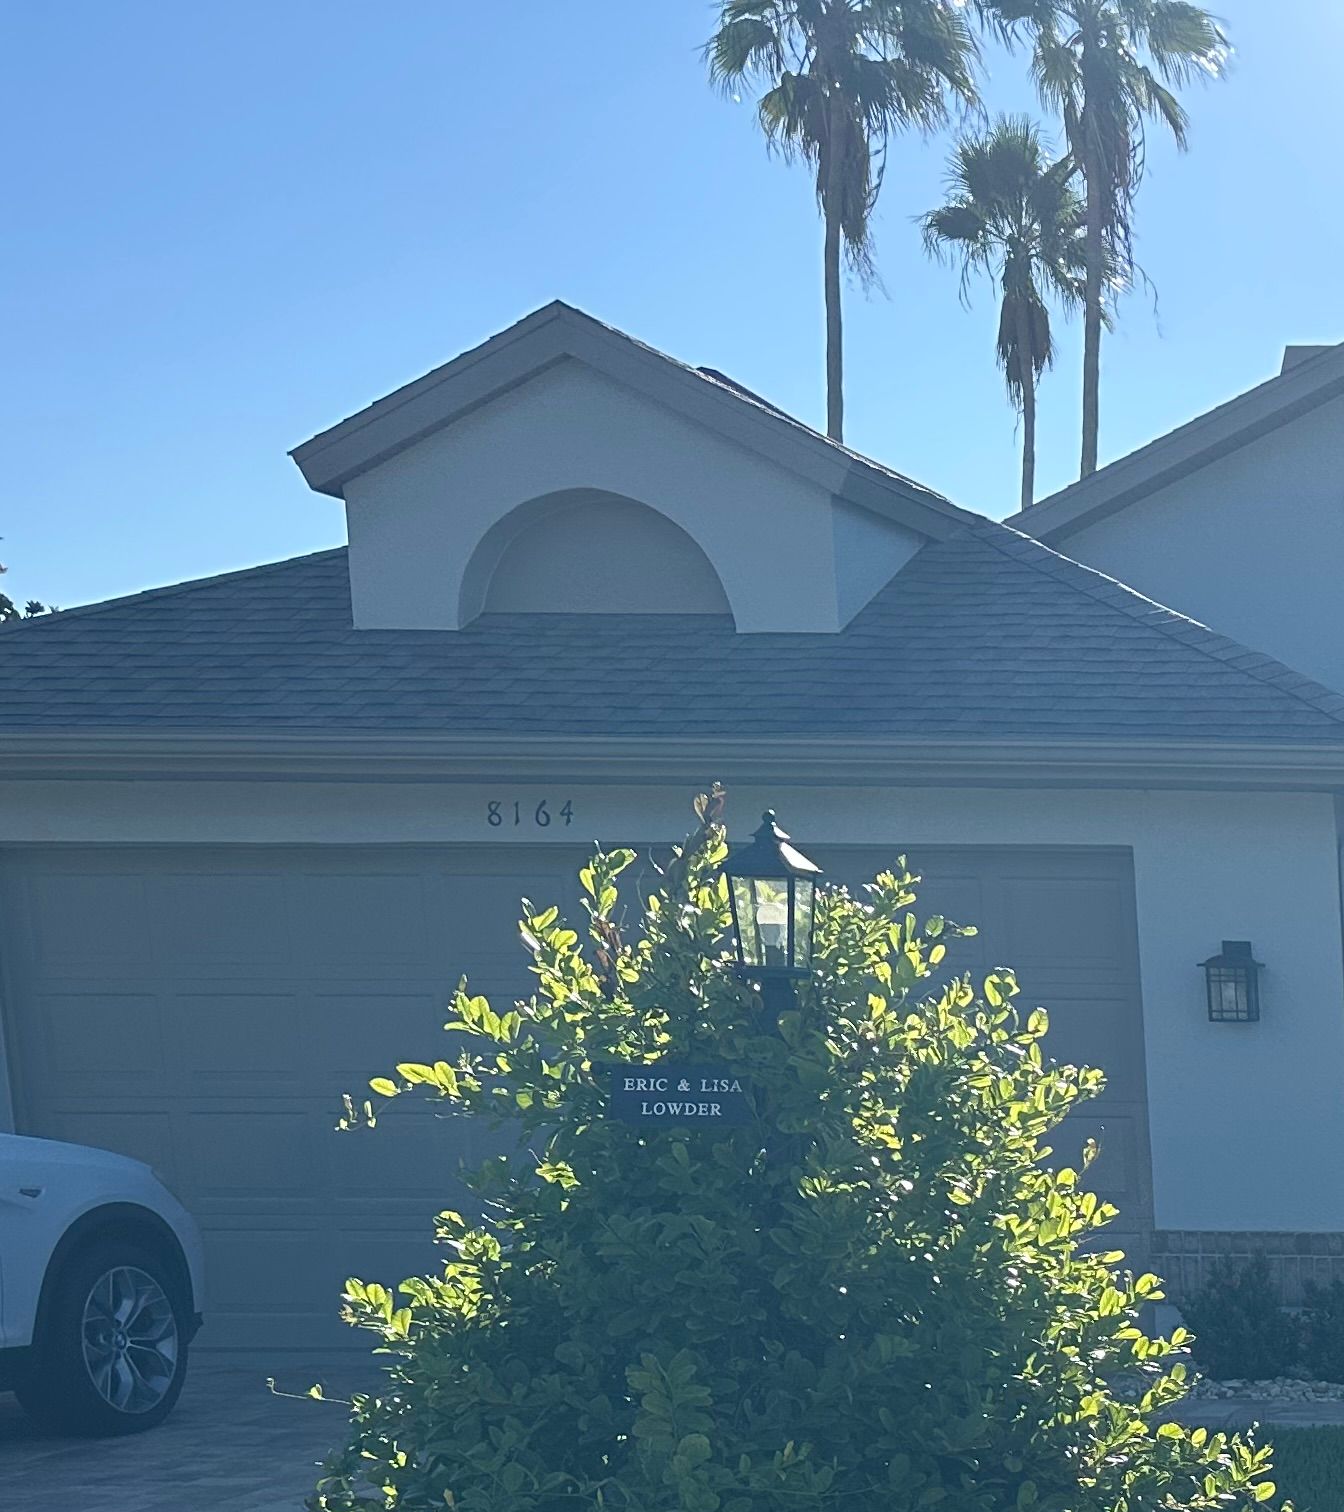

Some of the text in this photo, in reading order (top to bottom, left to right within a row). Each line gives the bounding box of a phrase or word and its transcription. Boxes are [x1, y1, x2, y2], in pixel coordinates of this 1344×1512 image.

[487, 799, 574, 827] 8164
[623, 1077, 743, 1093] ERIC & LISA
[641, 1102, 722, 1116] LOWDER
